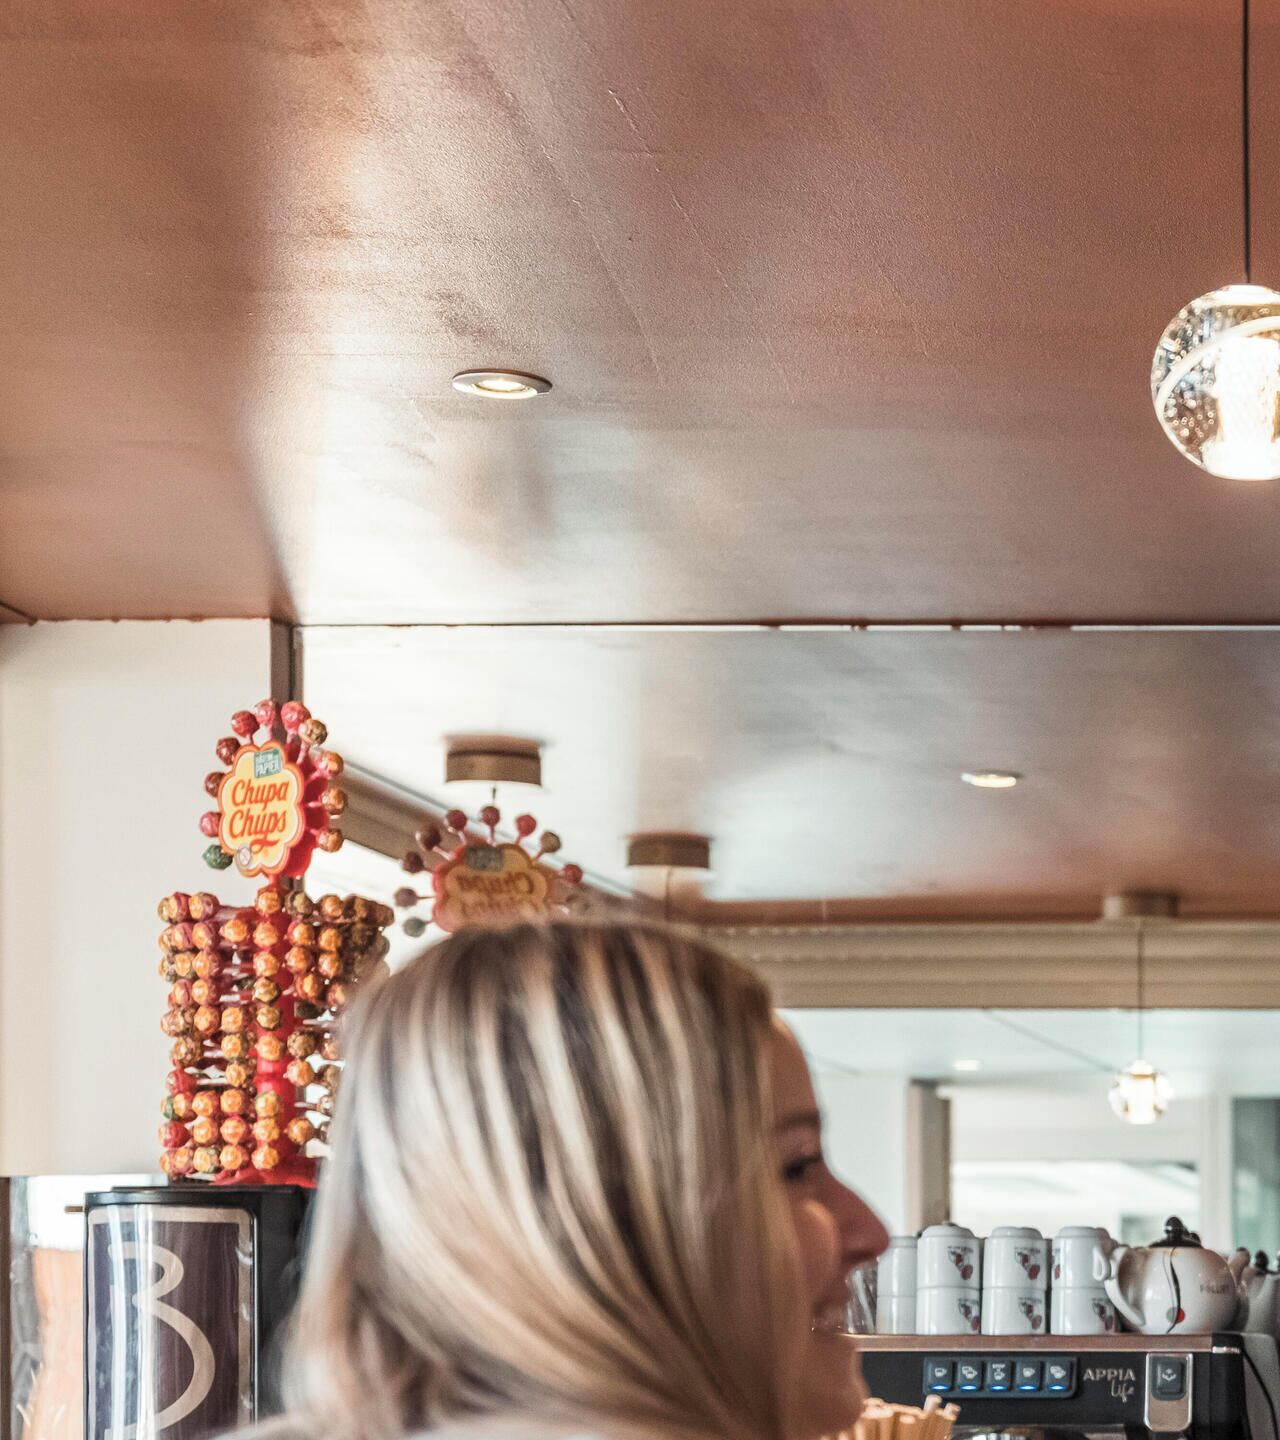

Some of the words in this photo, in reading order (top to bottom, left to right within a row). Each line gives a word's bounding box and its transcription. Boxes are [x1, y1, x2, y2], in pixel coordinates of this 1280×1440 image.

[231, 779, 289, 809] Chupa
[229, 807, 287, 853] Chups
[1083, 1367, 1136, 1382] APPIA
